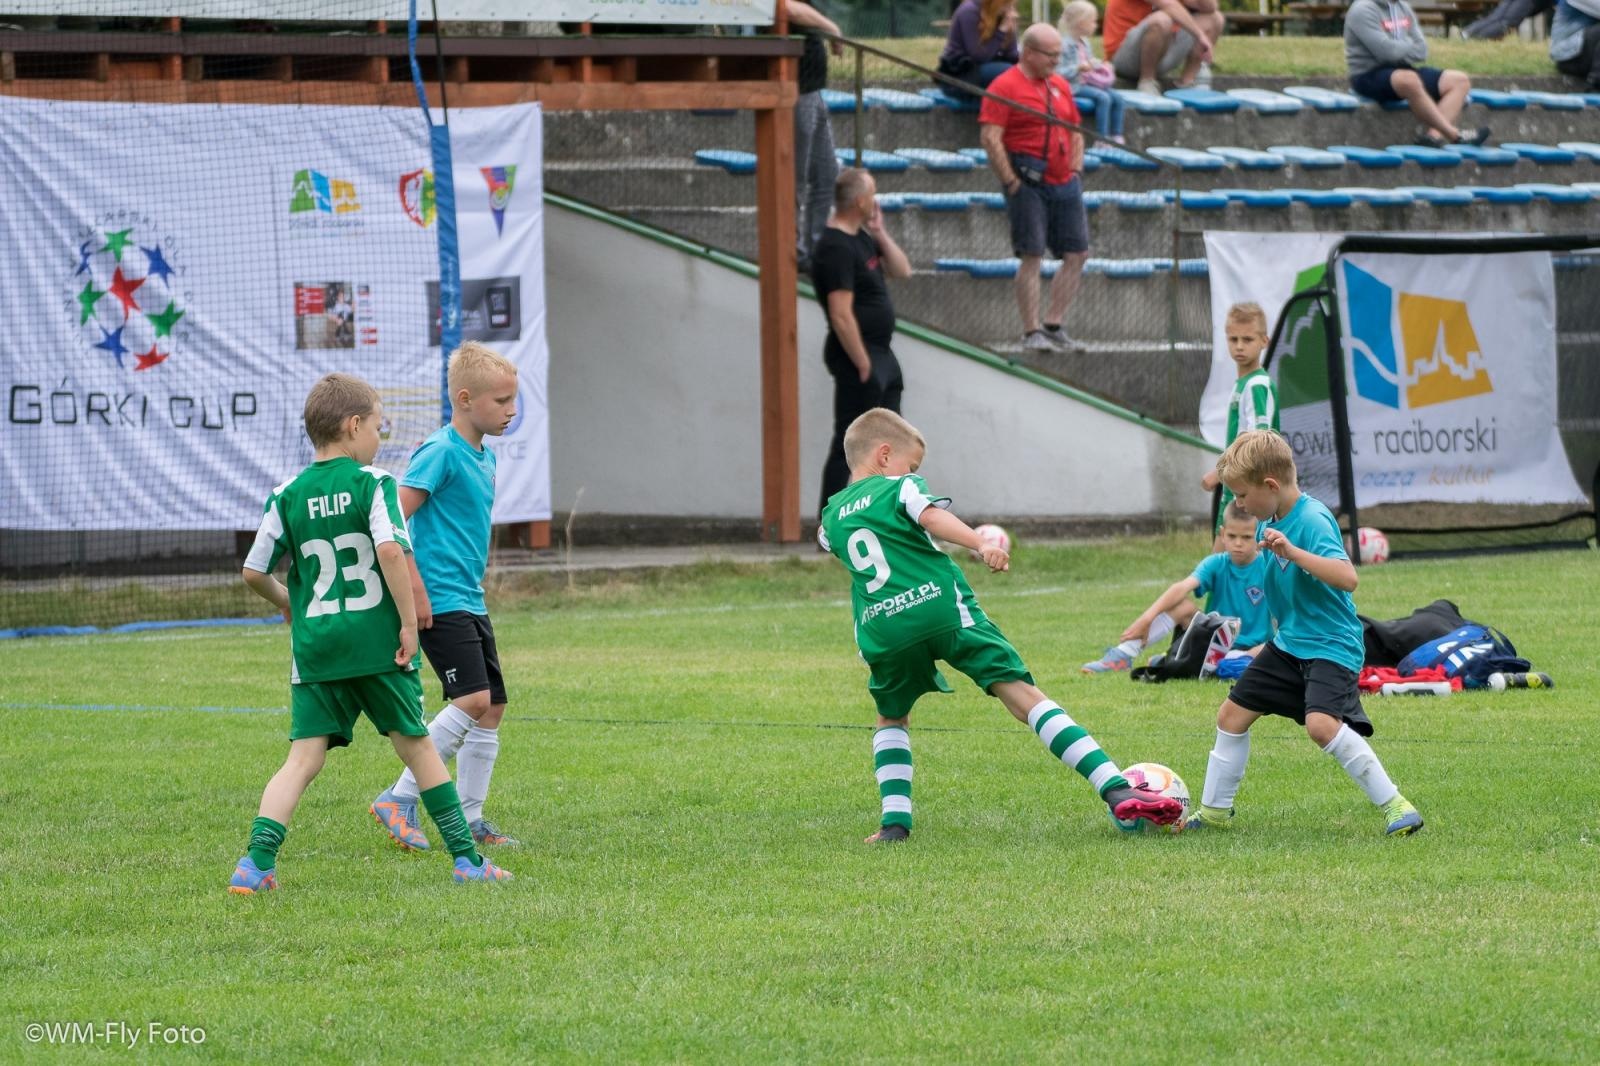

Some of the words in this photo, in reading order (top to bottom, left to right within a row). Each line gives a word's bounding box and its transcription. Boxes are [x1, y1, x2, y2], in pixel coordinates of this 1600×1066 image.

[9, 377, 149, 428] GÓRKI
[169, 392, 257, 431] CUP
[1373, 416, 1497, 455] raciborski
[307, 492, 352, 520] FILIP
[838, 495, 872, 520] ALAN
[300, 532, 383, 618] 23
[847, 528, 891, 594] 9
